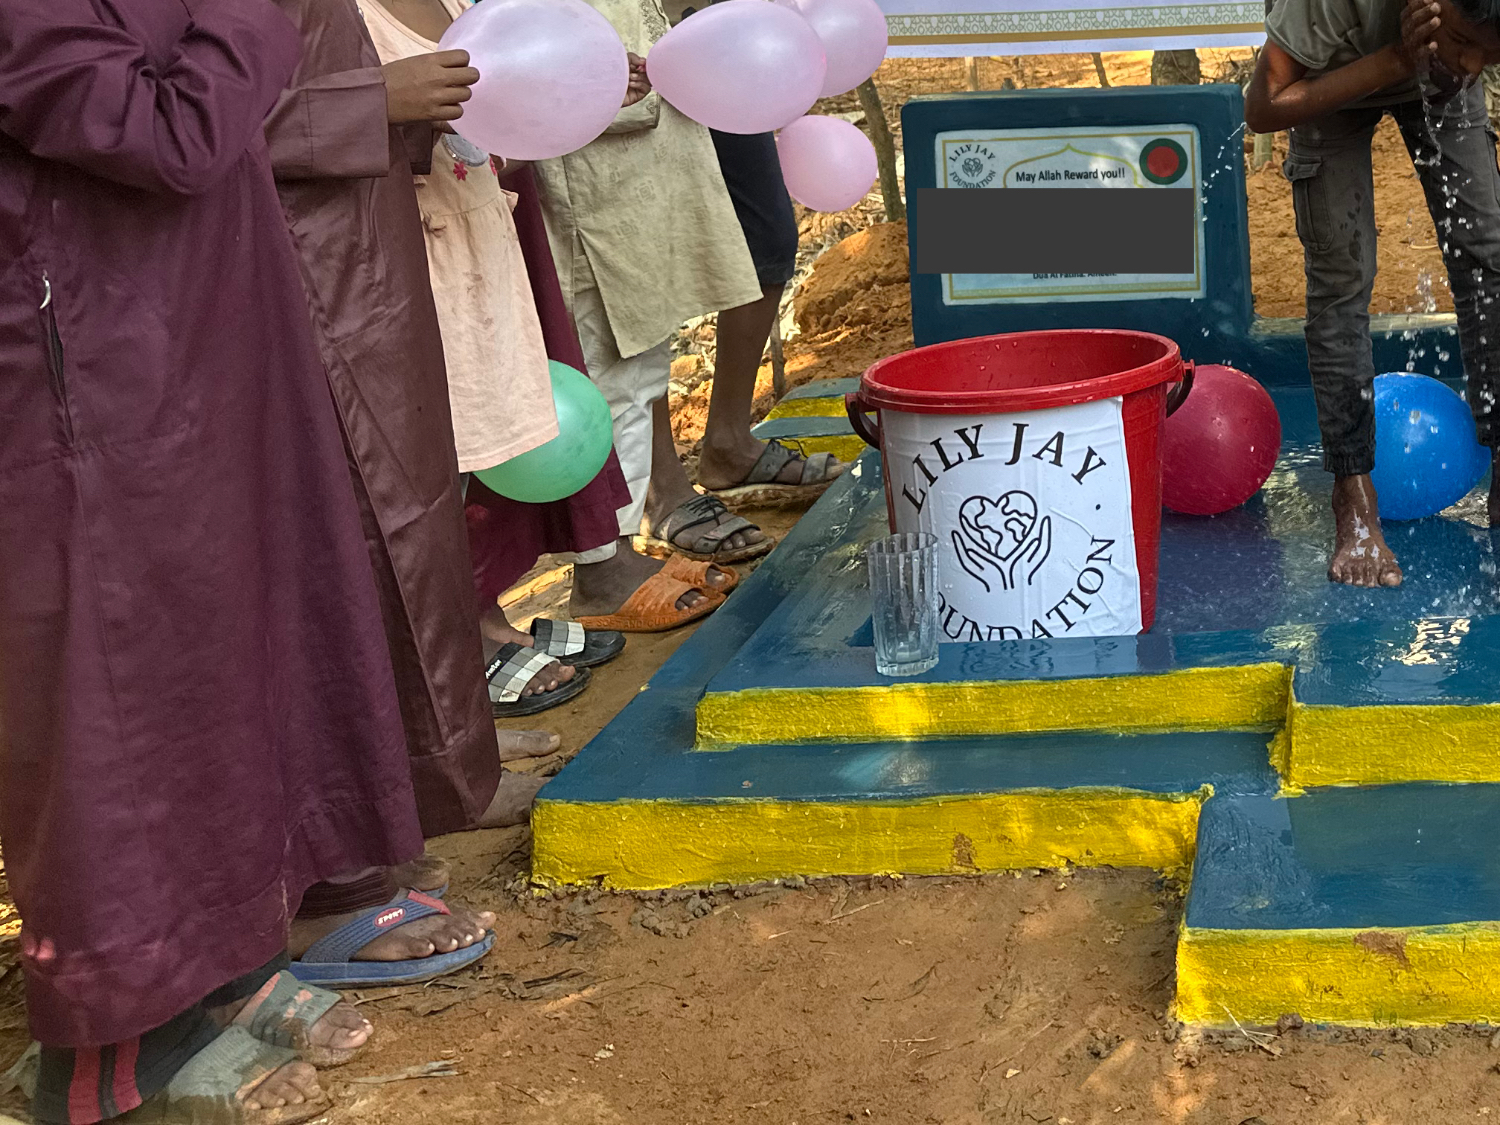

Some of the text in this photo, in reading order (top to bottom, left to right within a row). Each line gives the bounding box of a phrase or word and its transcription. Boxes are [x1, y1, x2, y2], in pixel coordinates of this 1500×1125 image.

[949, 144, 996, 162] LILY JAY
[949, 169, 996, 188] FOUNDATION
[1016, 167, 1125, 184] May Allah Reward you!!
[901, 422, 1107, 514] LILY JAY
